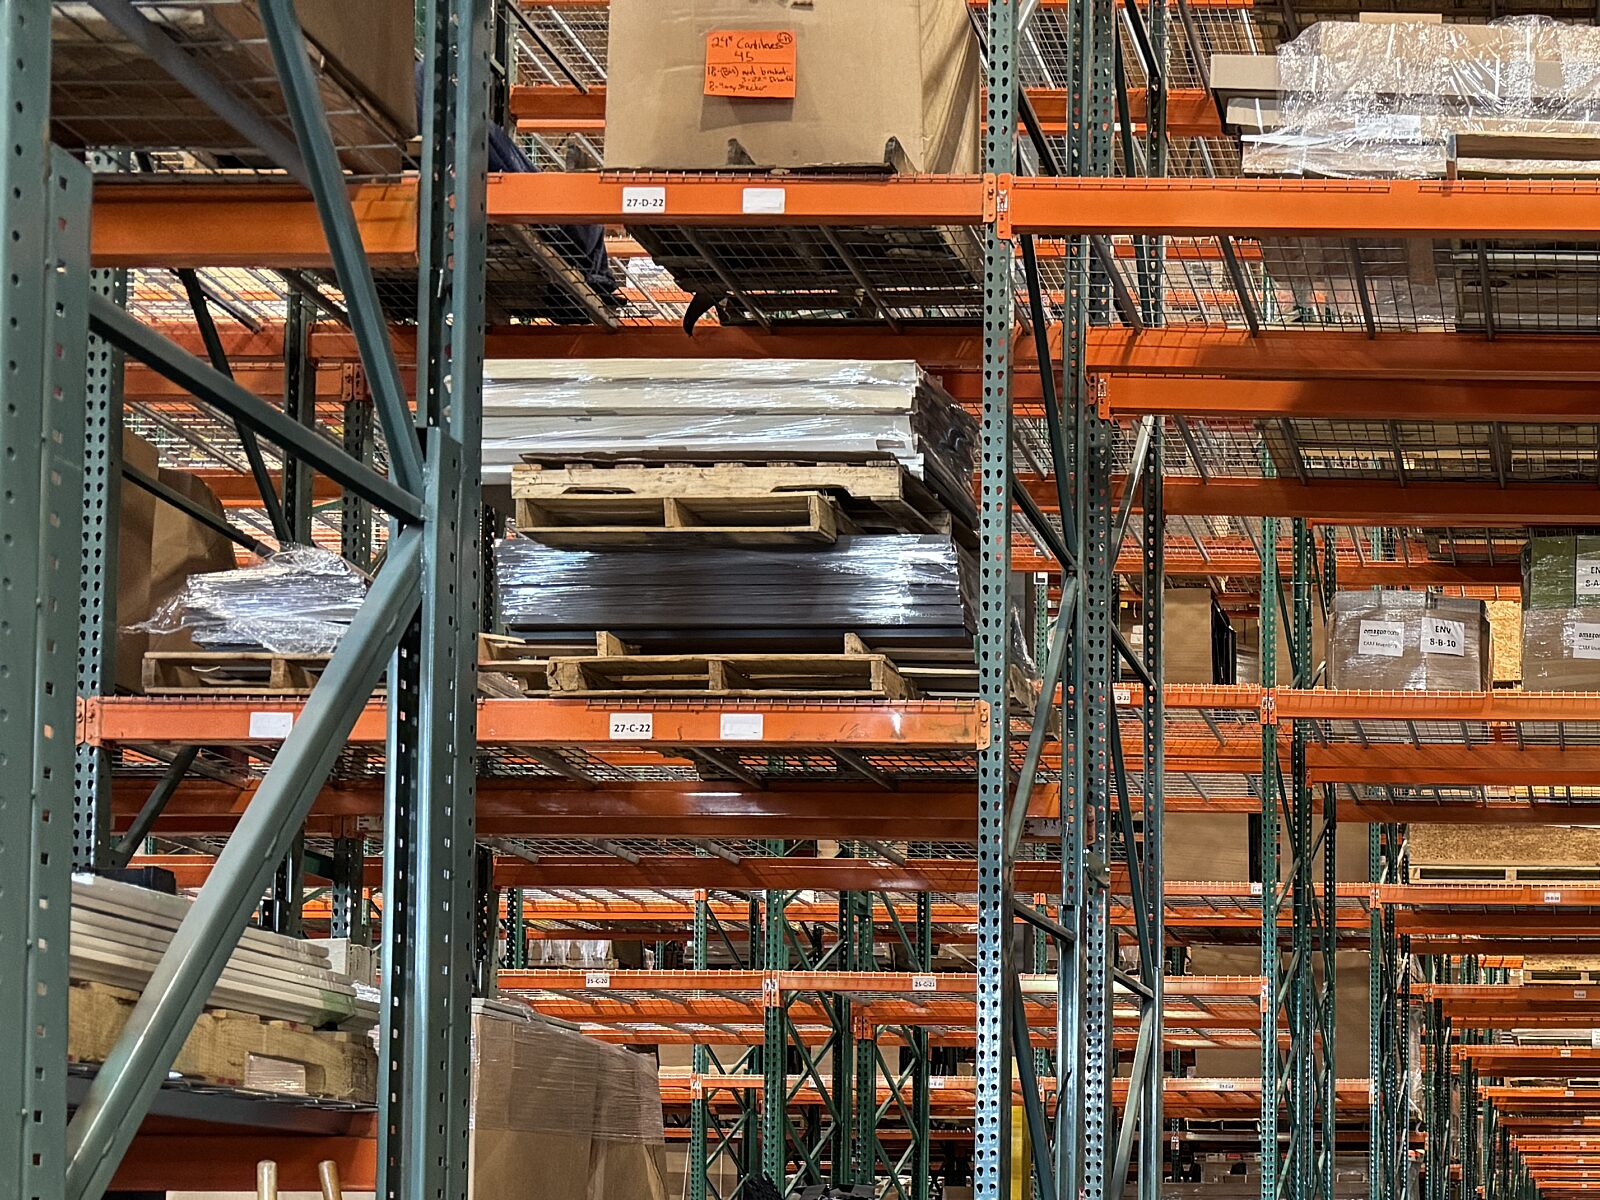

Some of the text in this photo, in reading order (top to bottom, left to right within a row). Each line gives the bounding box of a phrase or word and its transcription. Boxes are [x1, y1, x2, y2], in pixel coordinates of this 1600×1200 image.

[734, 50, 754, 62] 45
[626, 199, 664, 207] 27-D-22
[1435, 625, 1452, 635] ENV
[614, 723, 651, 733] 27-C-22
